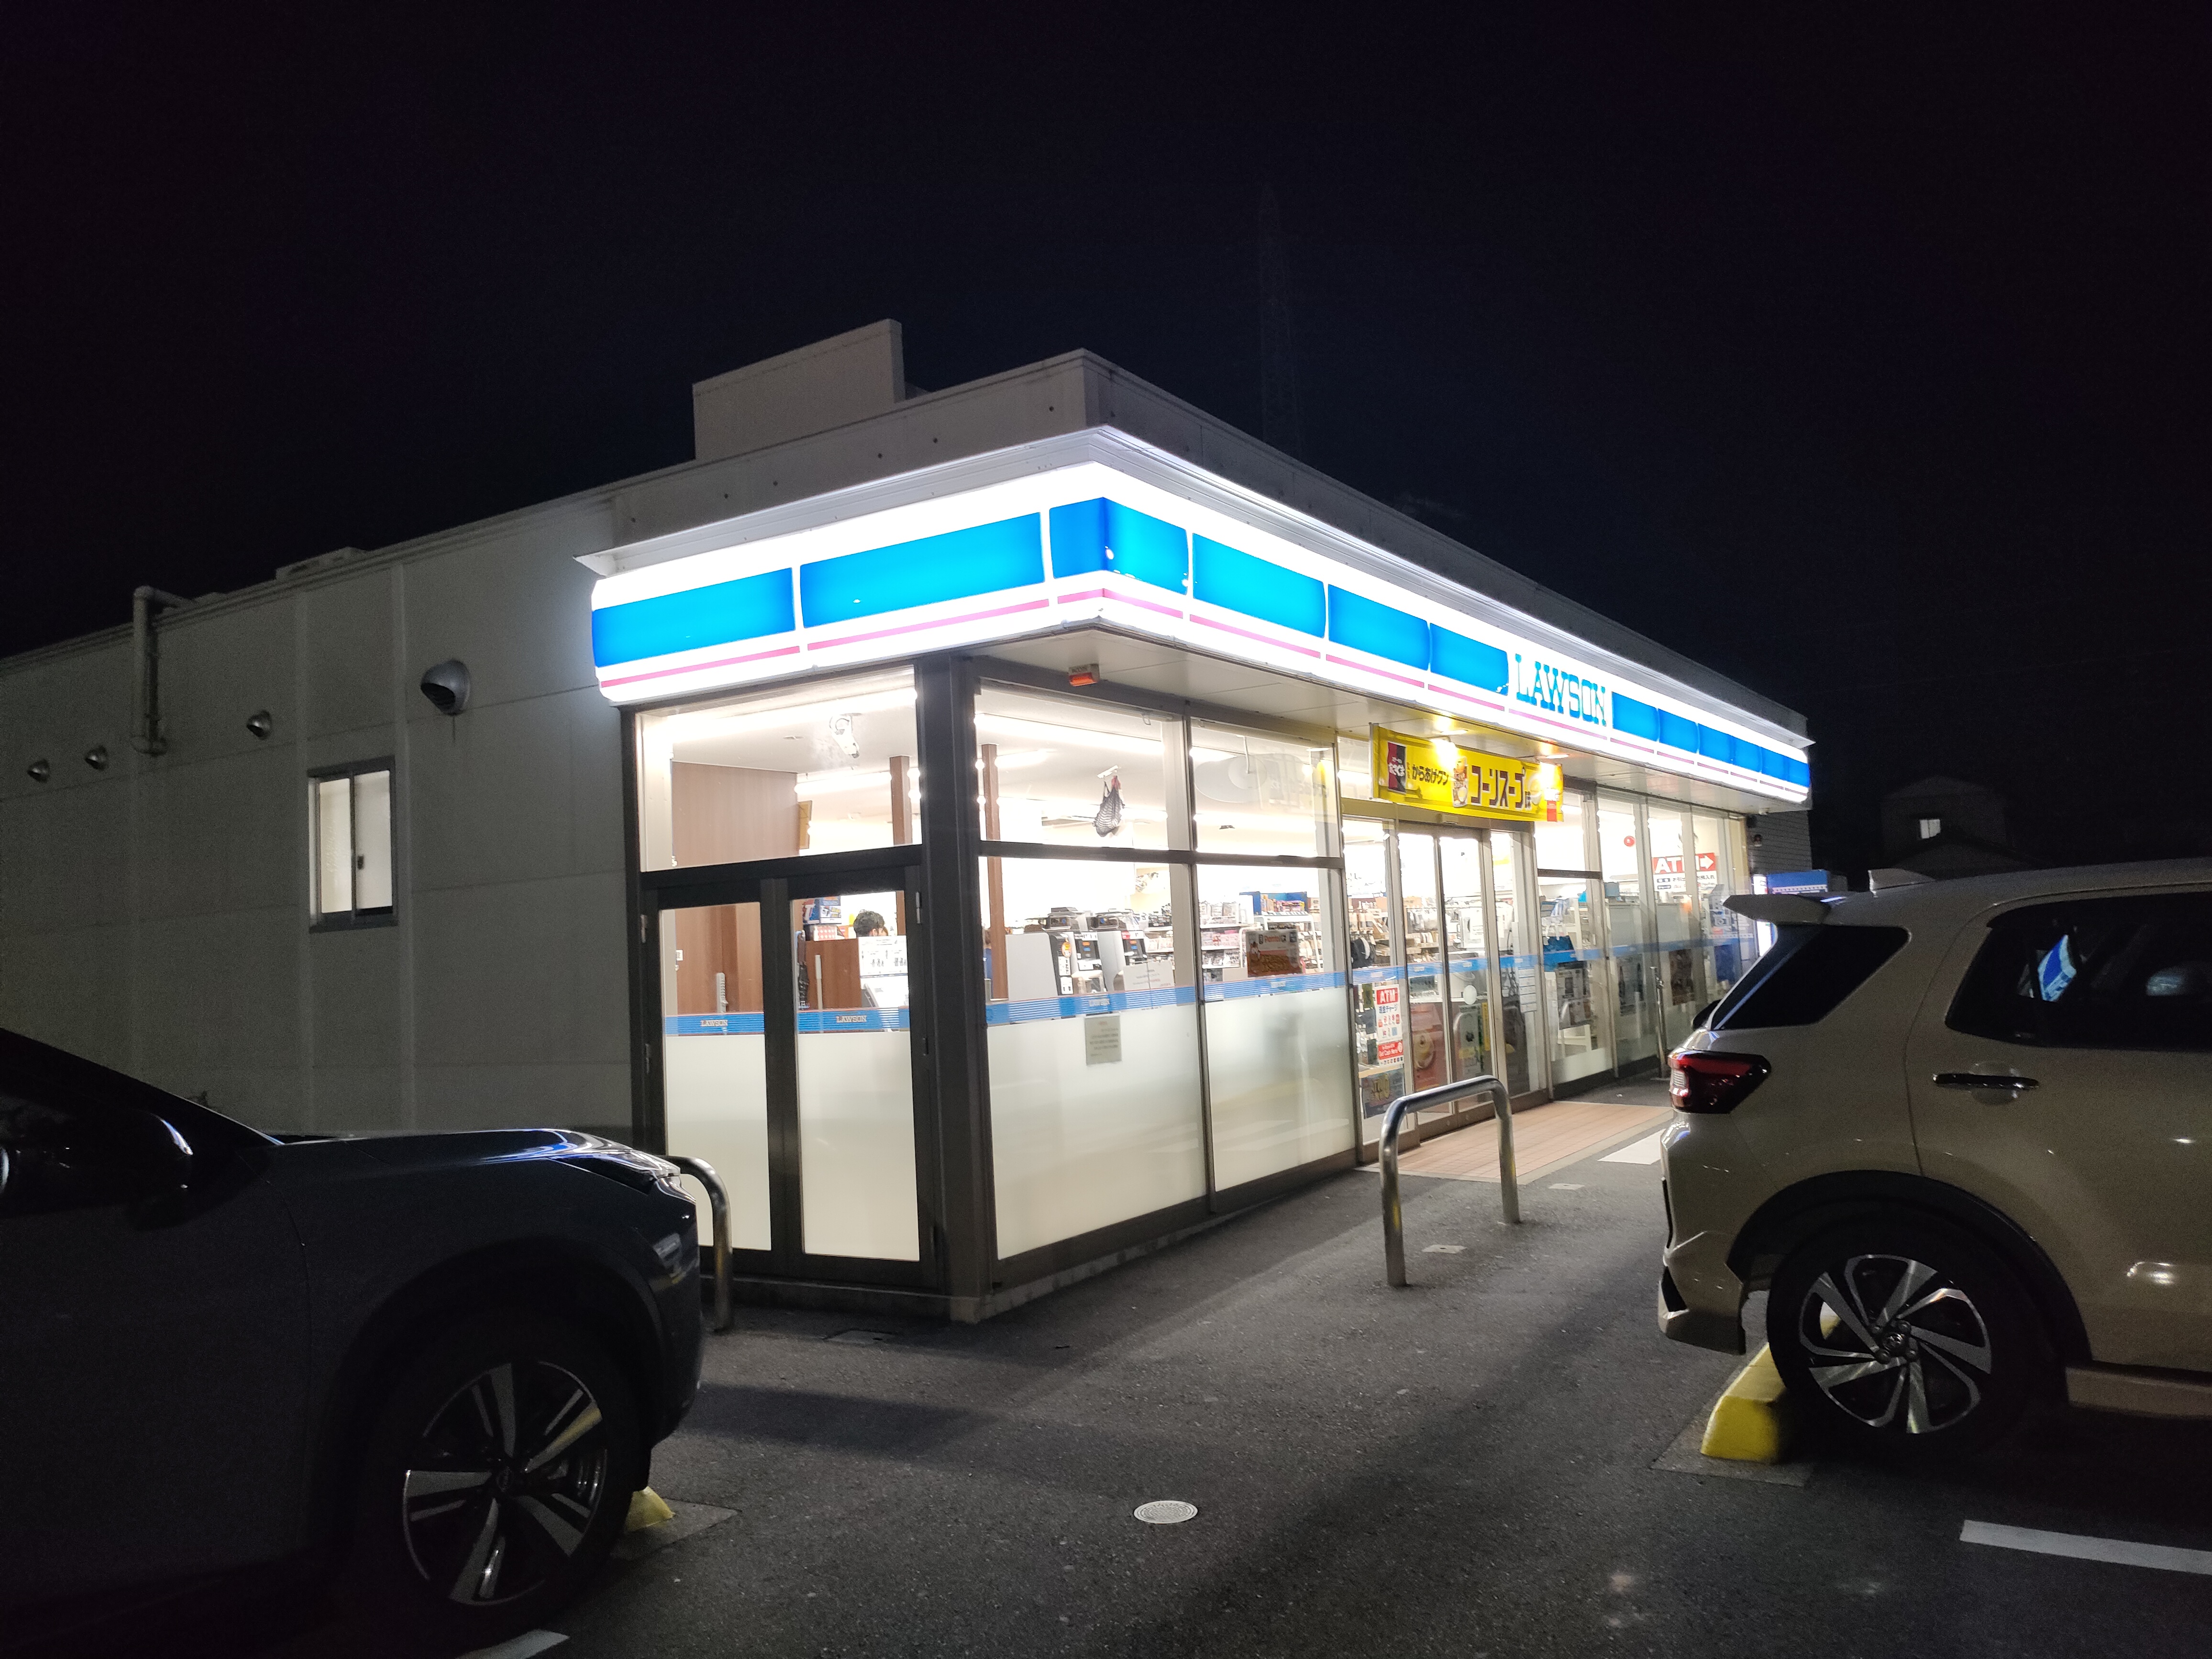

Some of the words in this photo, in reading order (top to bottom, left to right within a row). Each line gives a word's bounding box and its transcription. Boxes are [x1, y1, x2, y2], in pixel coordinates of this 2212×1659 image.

[1515, 653, 1606, 727] LAWSON
[1412, 764, 1449, 785] からあげクン
[1380, 989, 1396, 1004] ATM
[836, 1015, 867, 1023] LAWSON
